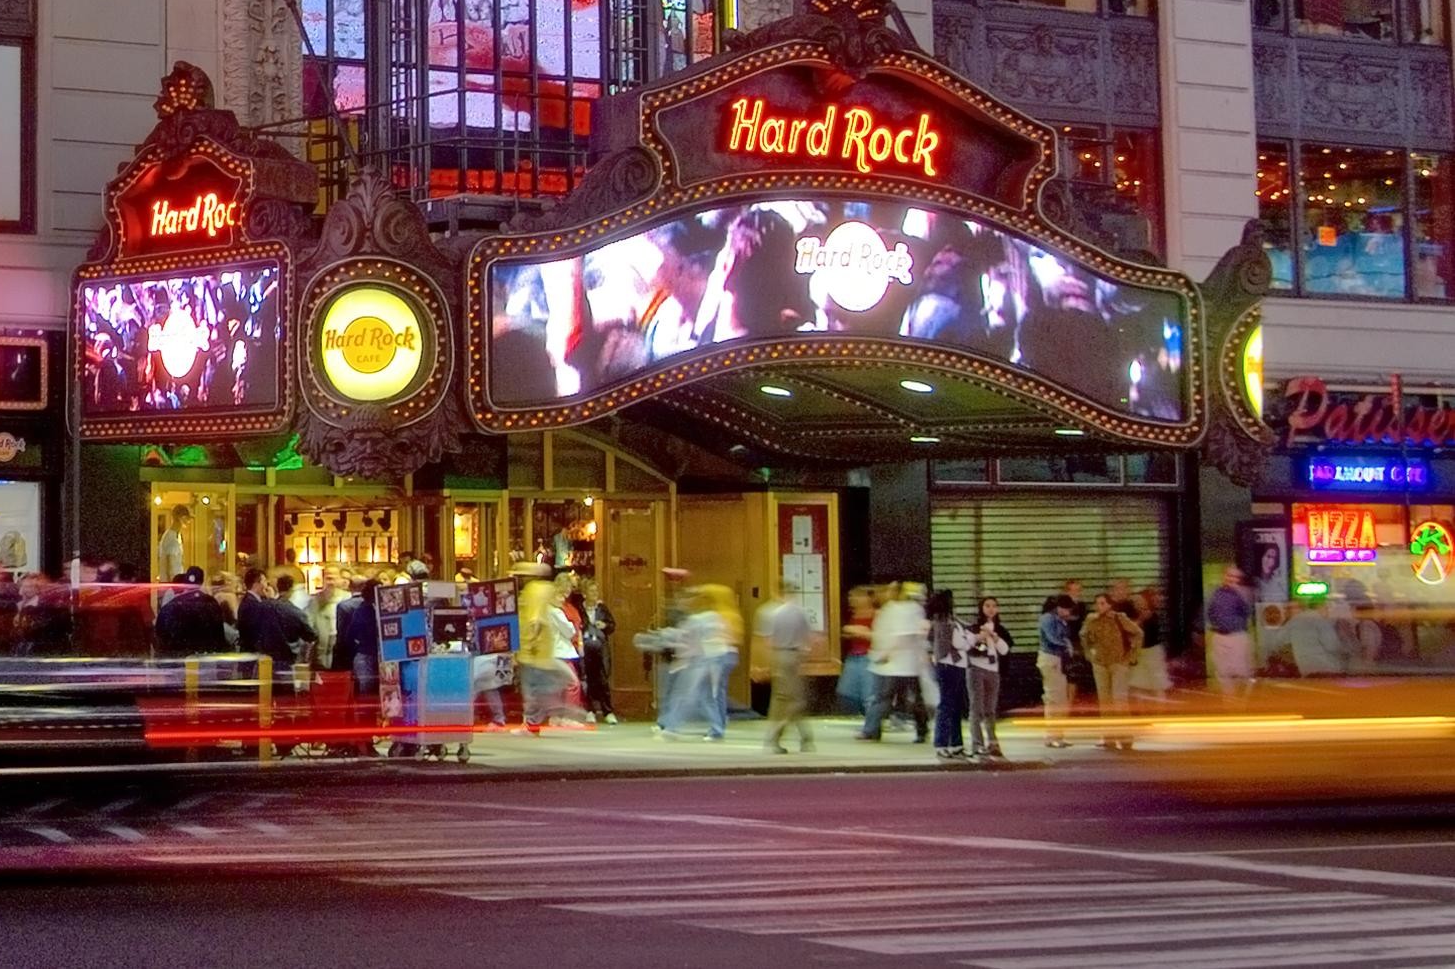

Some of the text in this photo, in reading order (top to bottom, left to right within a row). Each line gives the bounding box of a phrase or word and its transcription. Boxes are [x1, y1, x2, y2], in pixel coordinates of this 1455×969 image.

[729, 98, 939, 177] Hard Rock
[151, 192, 242, 237] Hard Roc
[798, 240, 853, 269] Hard
[324, 325, 415, 351] Hard Rock
[356, 354, 381, 364] CAFE
[5, 437, 26, 451] Rock
[1308, 510, 1377, 549] PIZZA
